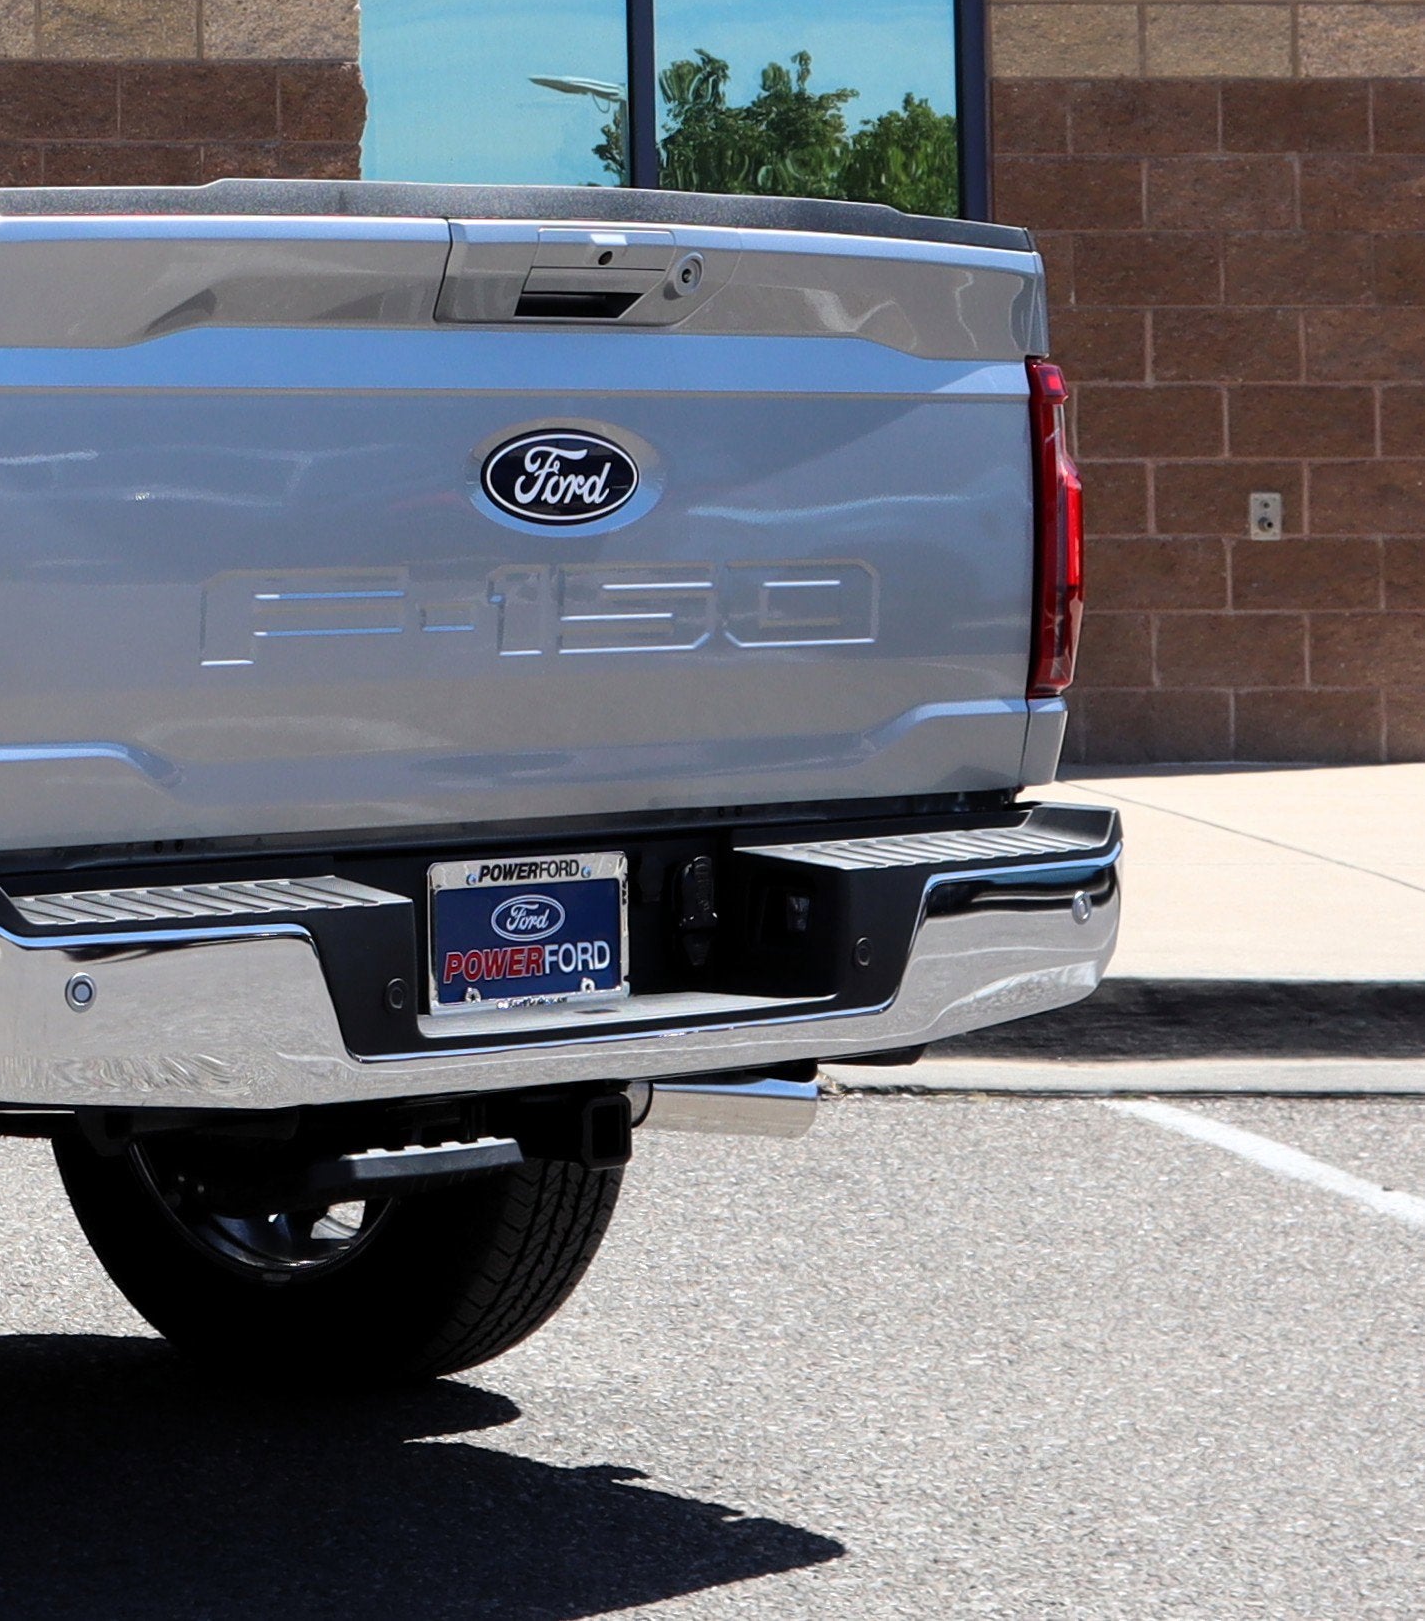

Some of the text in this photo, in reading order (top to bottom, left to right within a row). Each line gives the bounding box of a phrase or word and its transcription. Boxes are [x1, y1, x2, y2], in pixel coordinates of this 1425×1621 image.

[514, 445, 611, 505] Ford
[200, 559, 880, 667] F-150
[477, 859, 580, 883] POWERFORD
[506, 903, 550, 931] Ford
[443, 940, 611, 984] POWERFORD
